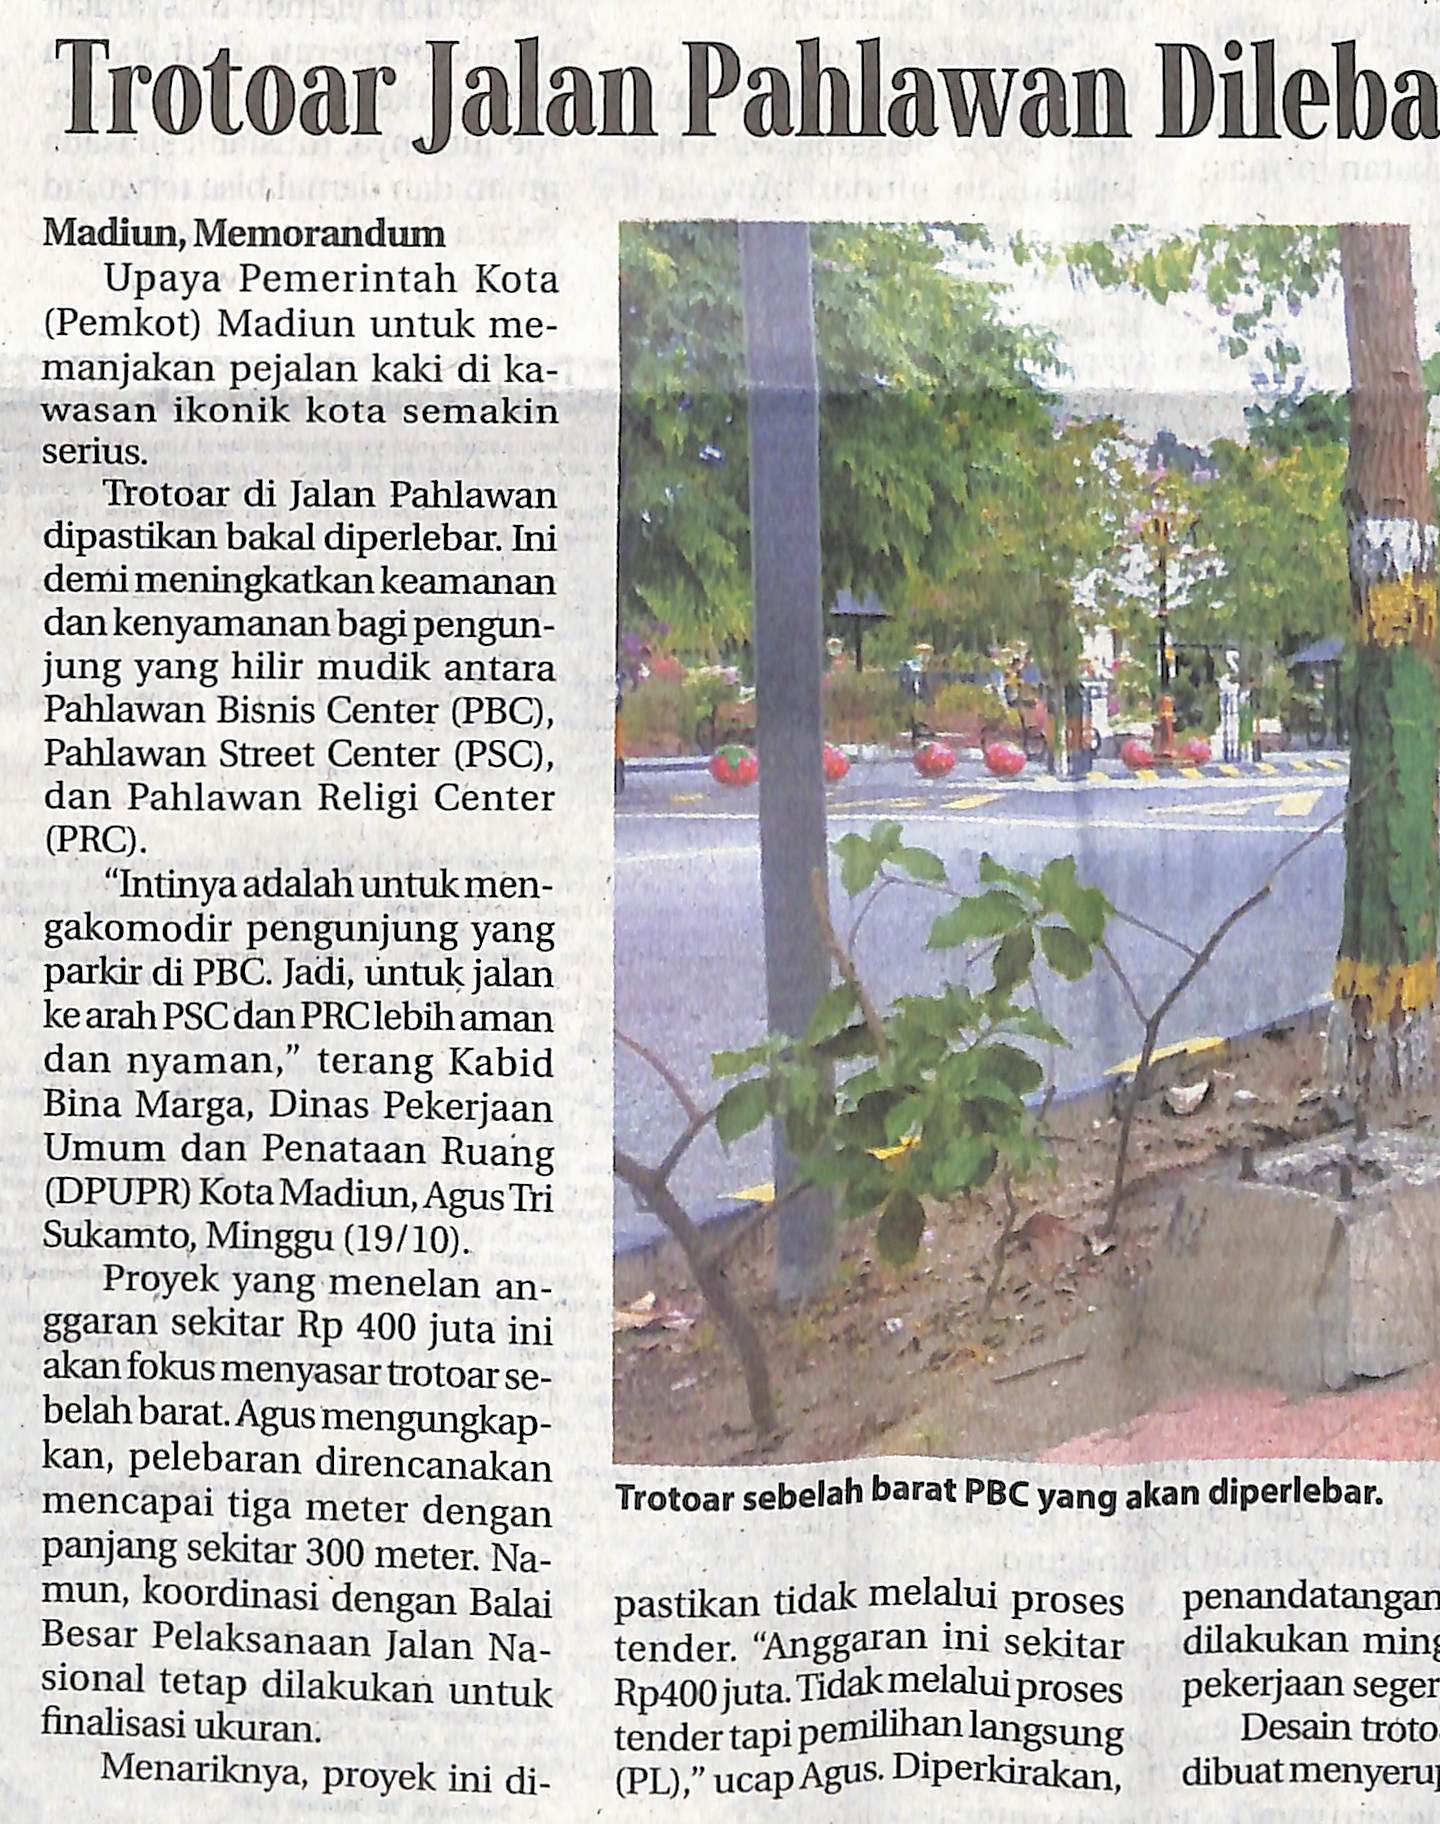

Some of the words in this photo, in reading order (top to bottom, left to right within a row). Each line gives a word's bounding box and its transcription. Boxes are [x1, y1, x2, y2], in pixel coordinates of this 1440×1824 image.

[55, 38, 397, 136] Trotoar
[411, 35, 659, 155] Jalan
[681, 36, 1133, 139] Pahlawan
[42, 215, 187, 253] Madiun,
[193, 216, 447, 248] Memorandum
[103, 262, 221, 301] Upaya
[239, 262, 457, 293] Pemerintah
[475, 263, 560, 294] Kota
[43, 519, 218, 558] dipastikan
[226, 521, 316, 551] bakal
[324, 521, 502, 559] diperlebar.
[511, 524, 558, 552] Ini
[44, 606, 108, 636] dan
[113, 606, 331, 645] kenyamanan
[336, 607, 408, 646] bagi
[413, 616, 555, 647] pengun-
[43, 692, 206, 723] Pahlawan
[216, 694, 315, 724] Bisnis
[327, 695, 440, 725] Center
[452, 696, 554, 730] (PBC),
[43, 955, 143, 993] parkir
[152, 956, 184, 986] di
[193, 957, 272, 986] PBC.
[282, 956, 354, 991] Jadi,
[364, 957, 465, 987] untuk
[471, 957, 554, 996] jalan
[44, 1042, 111, 1073] dan
[127, 1043, 300, 1083] nyaman,”
[317, 1048, 434, 1084] terang
[448, 1046, 554, 1078] Kabid
[45, 1176, 191, 1210] (DPUPR)
[199, 1177, 275, 1206] Kota
[279, 1177, 418, 1213] Madiun,
[422, 1180, 505, 1219] Agus
[508, 1182, 554, 1213] Tri
[43, 1218, 197, 1253] Sukamto,
[206, 1220, 335, 1259] Minggu
[344, 1223, 470, 1258] (19/10).
[43, 1313, 158, 1344] ggaran
[171, 1306, 285, 1338] sekitar
[297, 1309, 343, 1348] Rp
[356, 1312, 416, 1342] 400
[427, 1312, 496, 1351] juta
[508, 1315, 554, 1346] ini
[615, 1483, 735, 1512] Trotoar
[743, 1476, 863, 1511] sebelah
[871, 1474, 957, 1503] barat
[965, 1477, 1030, 1507] PBC
[1037, 1488, 1117, 1517] yang
[1125, 1479, 1200, 1510] akan
[1208, 1475, 1384, 1512] diperlebar.
[41, 1529, 178, 1569] panjang
[187, 1531, 297, 1565] sekitar
[306, 1537, 365, 1568] 300
[375, 1544, 479, 1571] meter.
[491, 1542, 552, 1573] Na-
[614, 1588, 761, 1626] pastikan
[773, 1580, 858, 1616] tidak
[868, 1575, 998, 1610] melalui
[1011, 1590, 1124, 1620] proses
[614, 1632, 737, 1663] tender.
[753, 1628, 928, 1665] “Anggaran
[943, 1621, 990, 1653] ini
[1004, 1627, 1125, 1660] sekitar
[1183, 1623, 1349, 1656] dilakukan
[614, 1677, 717, 1716] Rp400
[720, 1677, 791, 1715] juta.
[795, 1665, 884, 1702] Tidak
[887, 1663, 1011, 1698] melalui
[1015, 1678, 1123, 1708] proses
[1182, 1667, 1345, 1708] pekerjaan
[41, 1704, 186, 1739] finalisasi
[194, 1710, 321, 1744] ukuran.
[614, 1721, 724, 1752] tender
[729, 1725, 792, 1757] tapi
[798, 1707, 964, 1755] pemilihan
[968, 1709, 1125, 1757] langsung
[1240, 1711, 1353, 1741] Desain
[101, 1751, 308, 1793] Menariknya,
[322, 1761, 437, 1797] proyek
[448, 1764, 492, 1793] ini
[505, 1765, 551, 1796] di-
[616, 1765, 705, 1799] (PL),”
[714, 1770, 794, 1800] ucap
[799, 1761, 884, 1795] Agus.
[892, 1752, 1121, 1795] Diperkirakan,
[1182, 1756, 1285, 1786] dibuat
